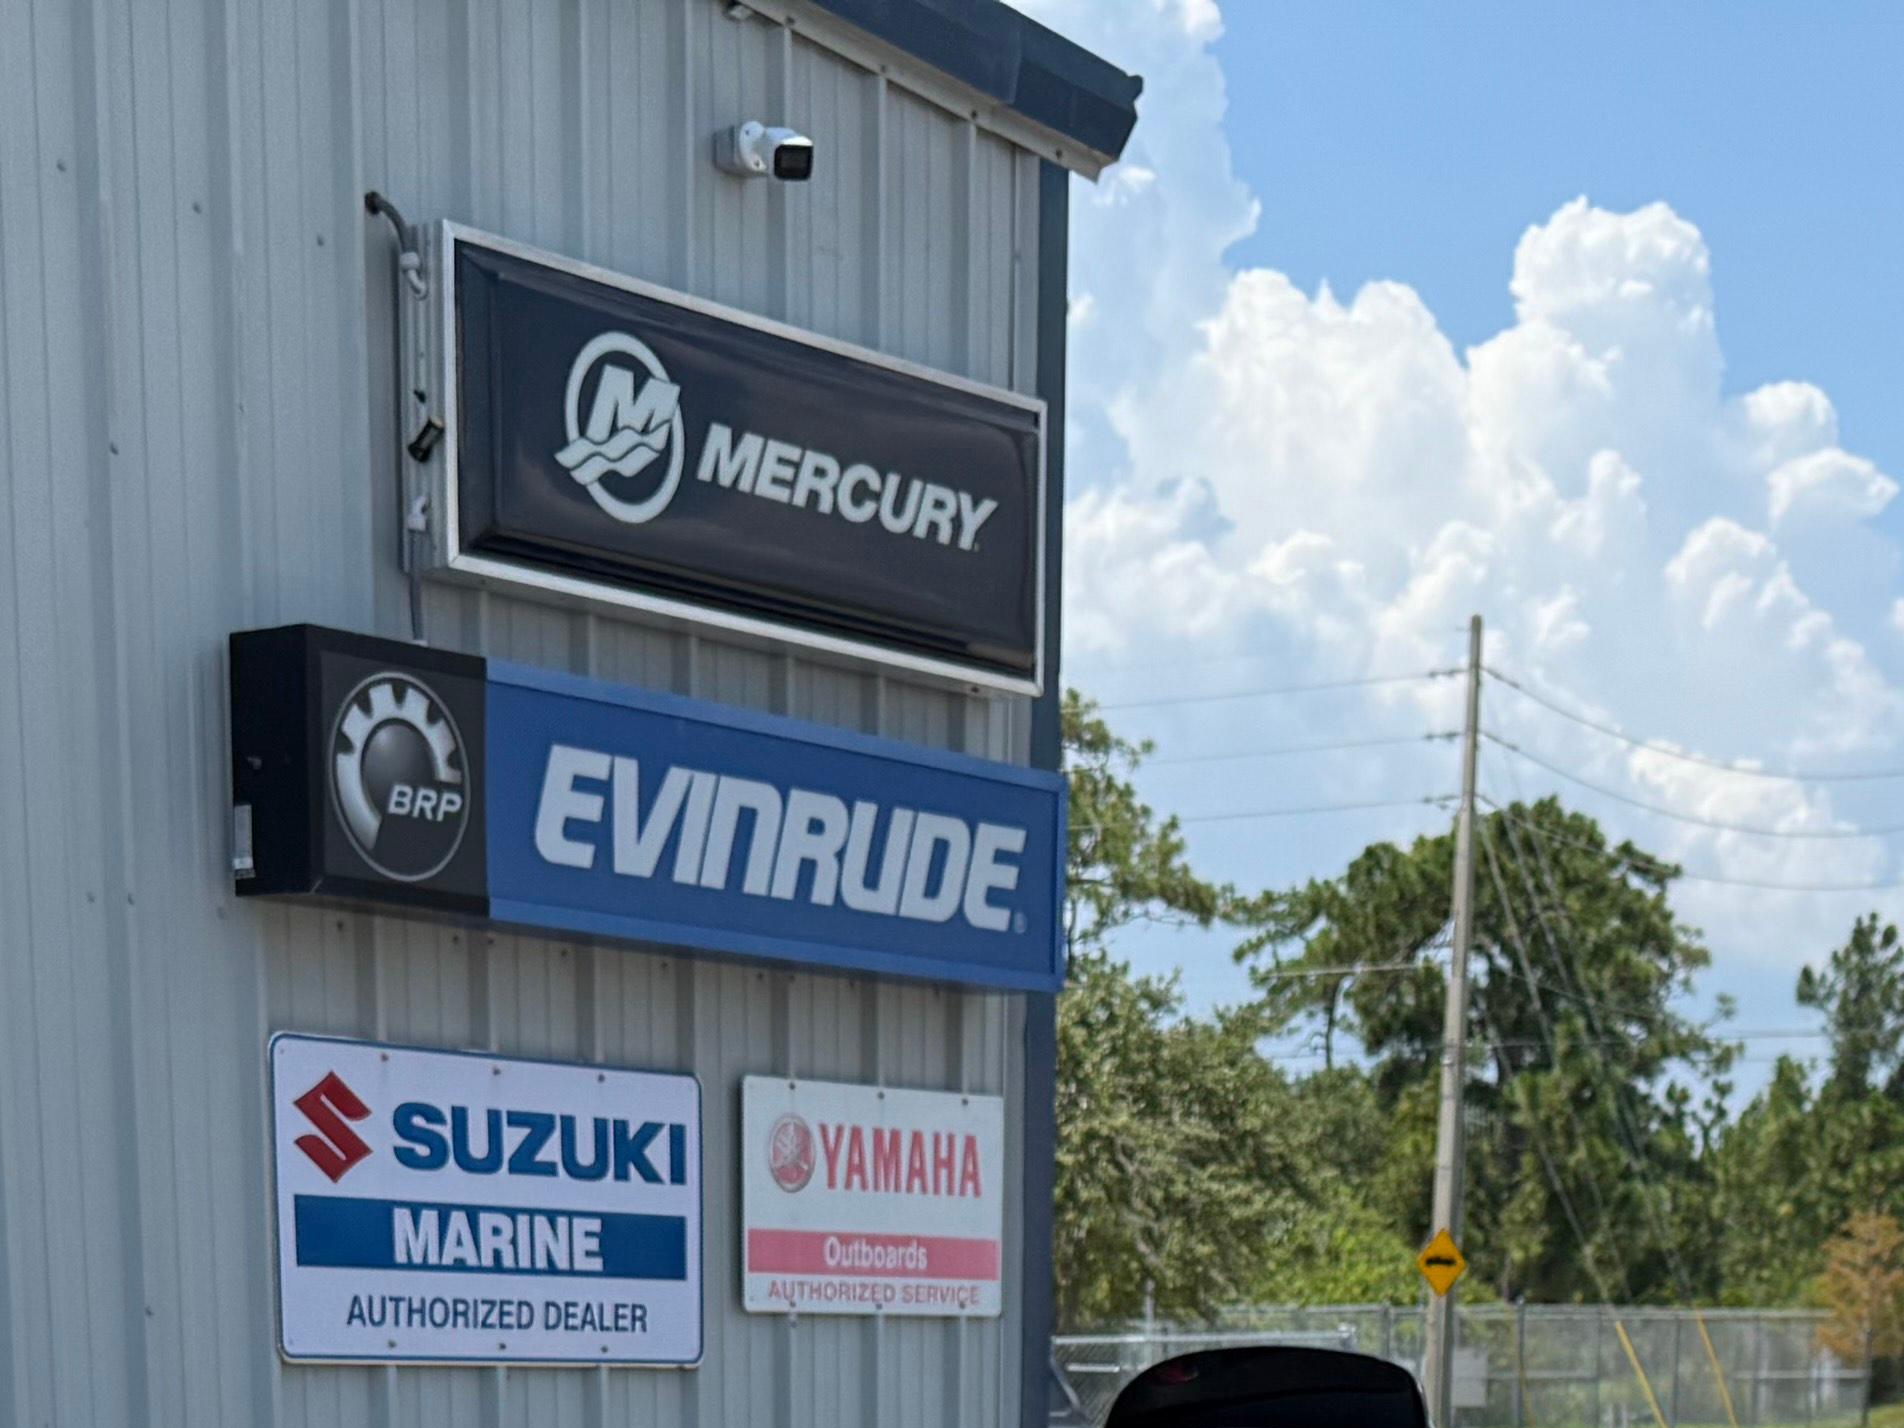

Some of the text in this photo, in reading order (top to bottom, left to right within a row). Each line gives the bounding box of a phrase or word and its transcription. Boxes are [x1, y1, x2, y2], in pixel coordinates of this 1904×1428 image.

[696, 421, 999, 552] MERCURY
[387, 784, 464, 824] BRP
[533, 743, 1028, 934] EVINRUDE
[391, 1101, 688, 1187] SUZUKI
[818, 1123, 983, 1199] YAMAHA
[392, 1206, 605, 1274] MARINE
[823, 1235, 929, 1271] Outboards
[346, 1294, 649, 1335] AUTHORIZED DEALER
[768, 1280, 981, 1307] AUTHORIZED SERVICE
